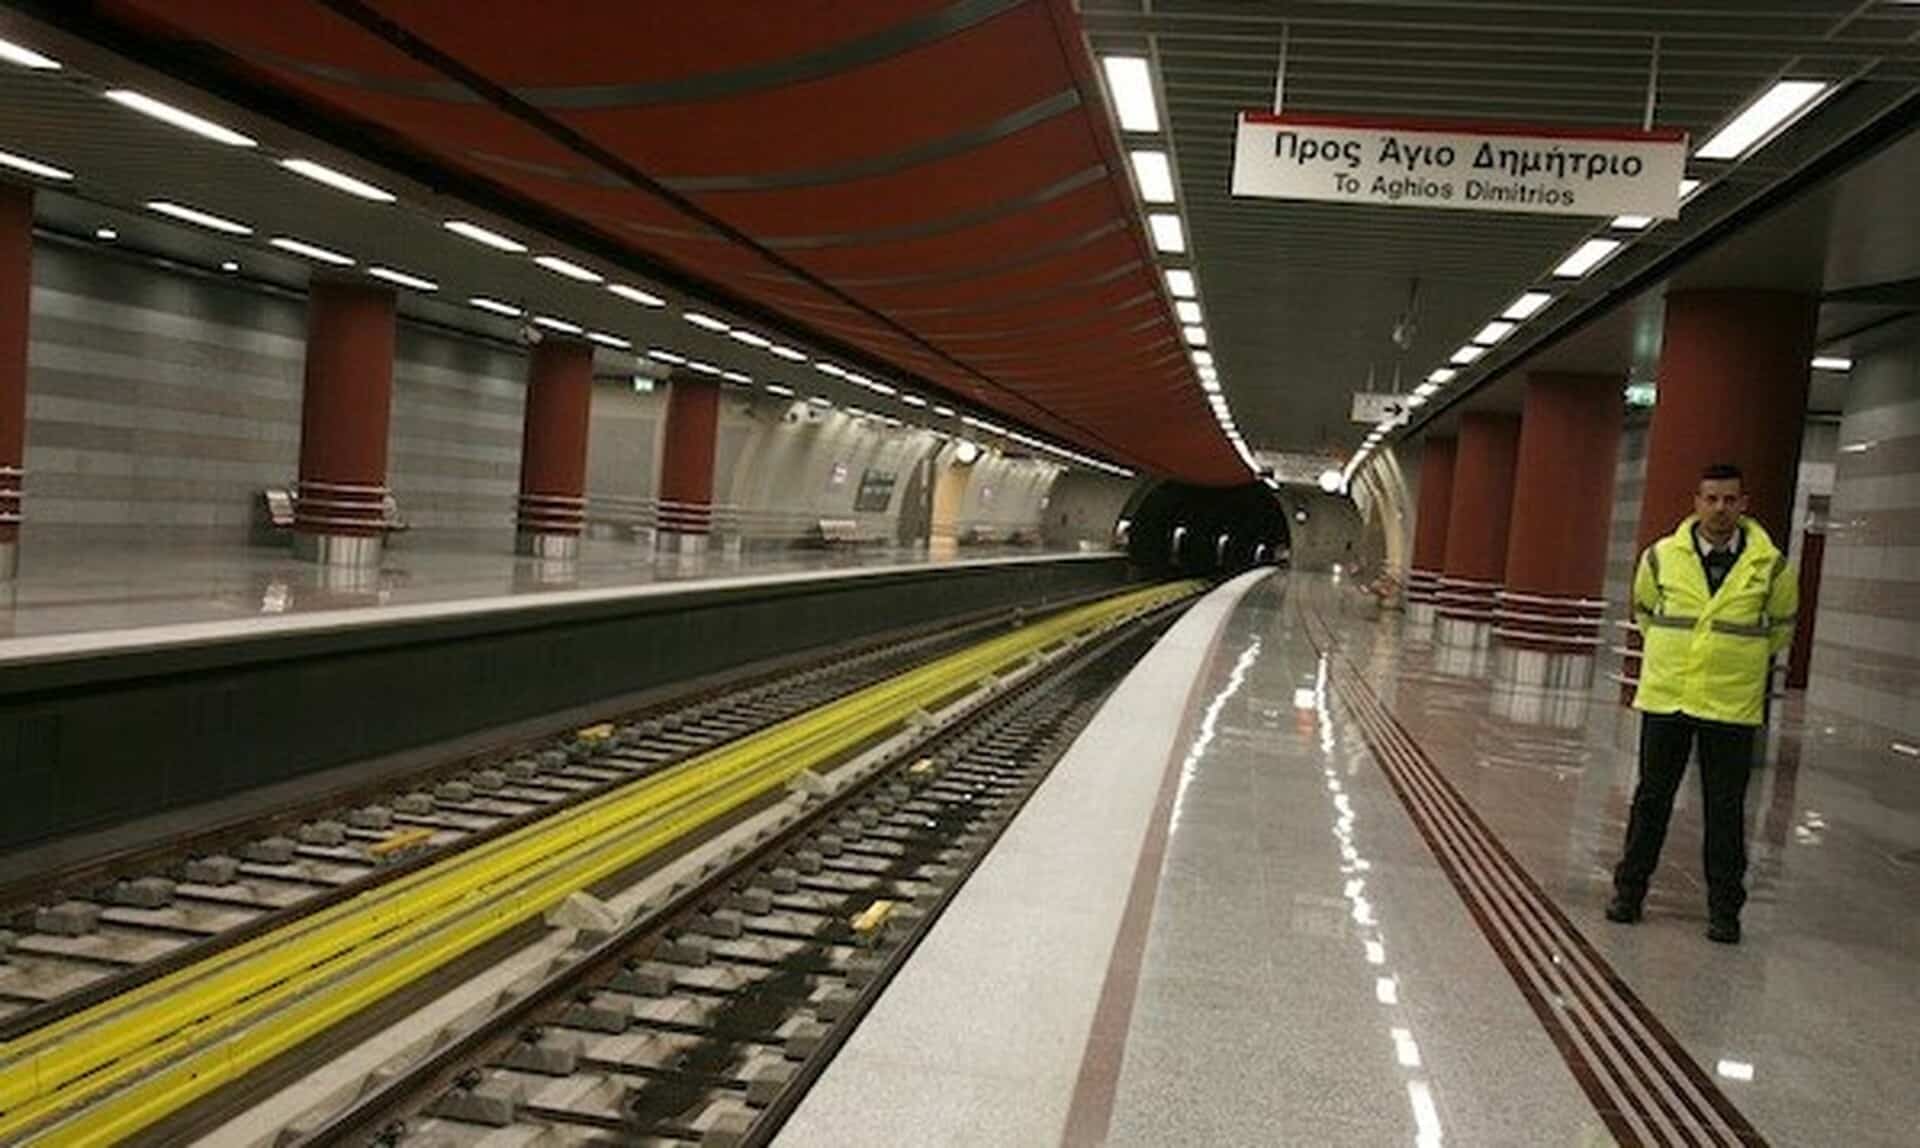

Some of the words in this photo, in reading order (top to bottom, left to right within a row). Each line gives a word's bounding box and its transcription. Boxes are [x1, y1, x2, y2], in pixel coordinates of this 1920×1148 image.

[1274, 131, 1362, 169] Προς
[1472, 142, 1644, 180] Δημήτριο
[1334, 173, 1361, 195] To
[1370, 176, 1455, 201] Aghios
[1465, 180, 1576, 206] Dimitrios
